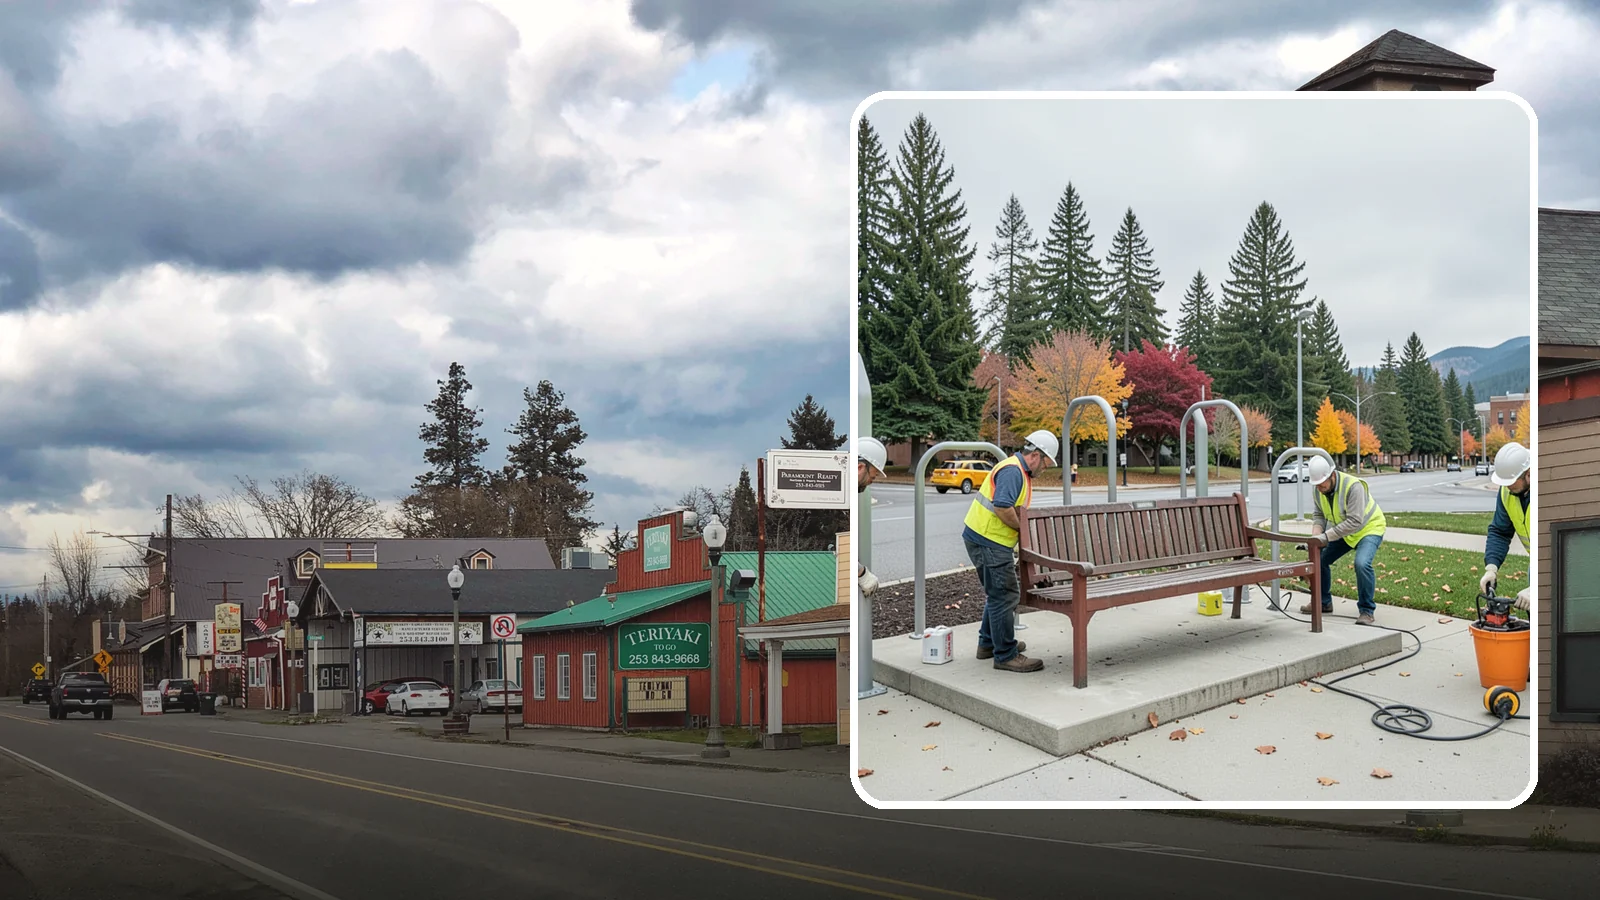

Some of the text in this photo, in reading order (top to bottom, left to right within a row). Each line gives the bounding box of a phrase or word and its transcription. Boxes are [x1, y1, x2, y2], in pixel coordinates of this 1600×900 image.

[646, 531, 669, 549] TERIYAKI
[625, 627, 702, 646] TERIYAKI
[629, 653, 700, 664] 253 843-9668
